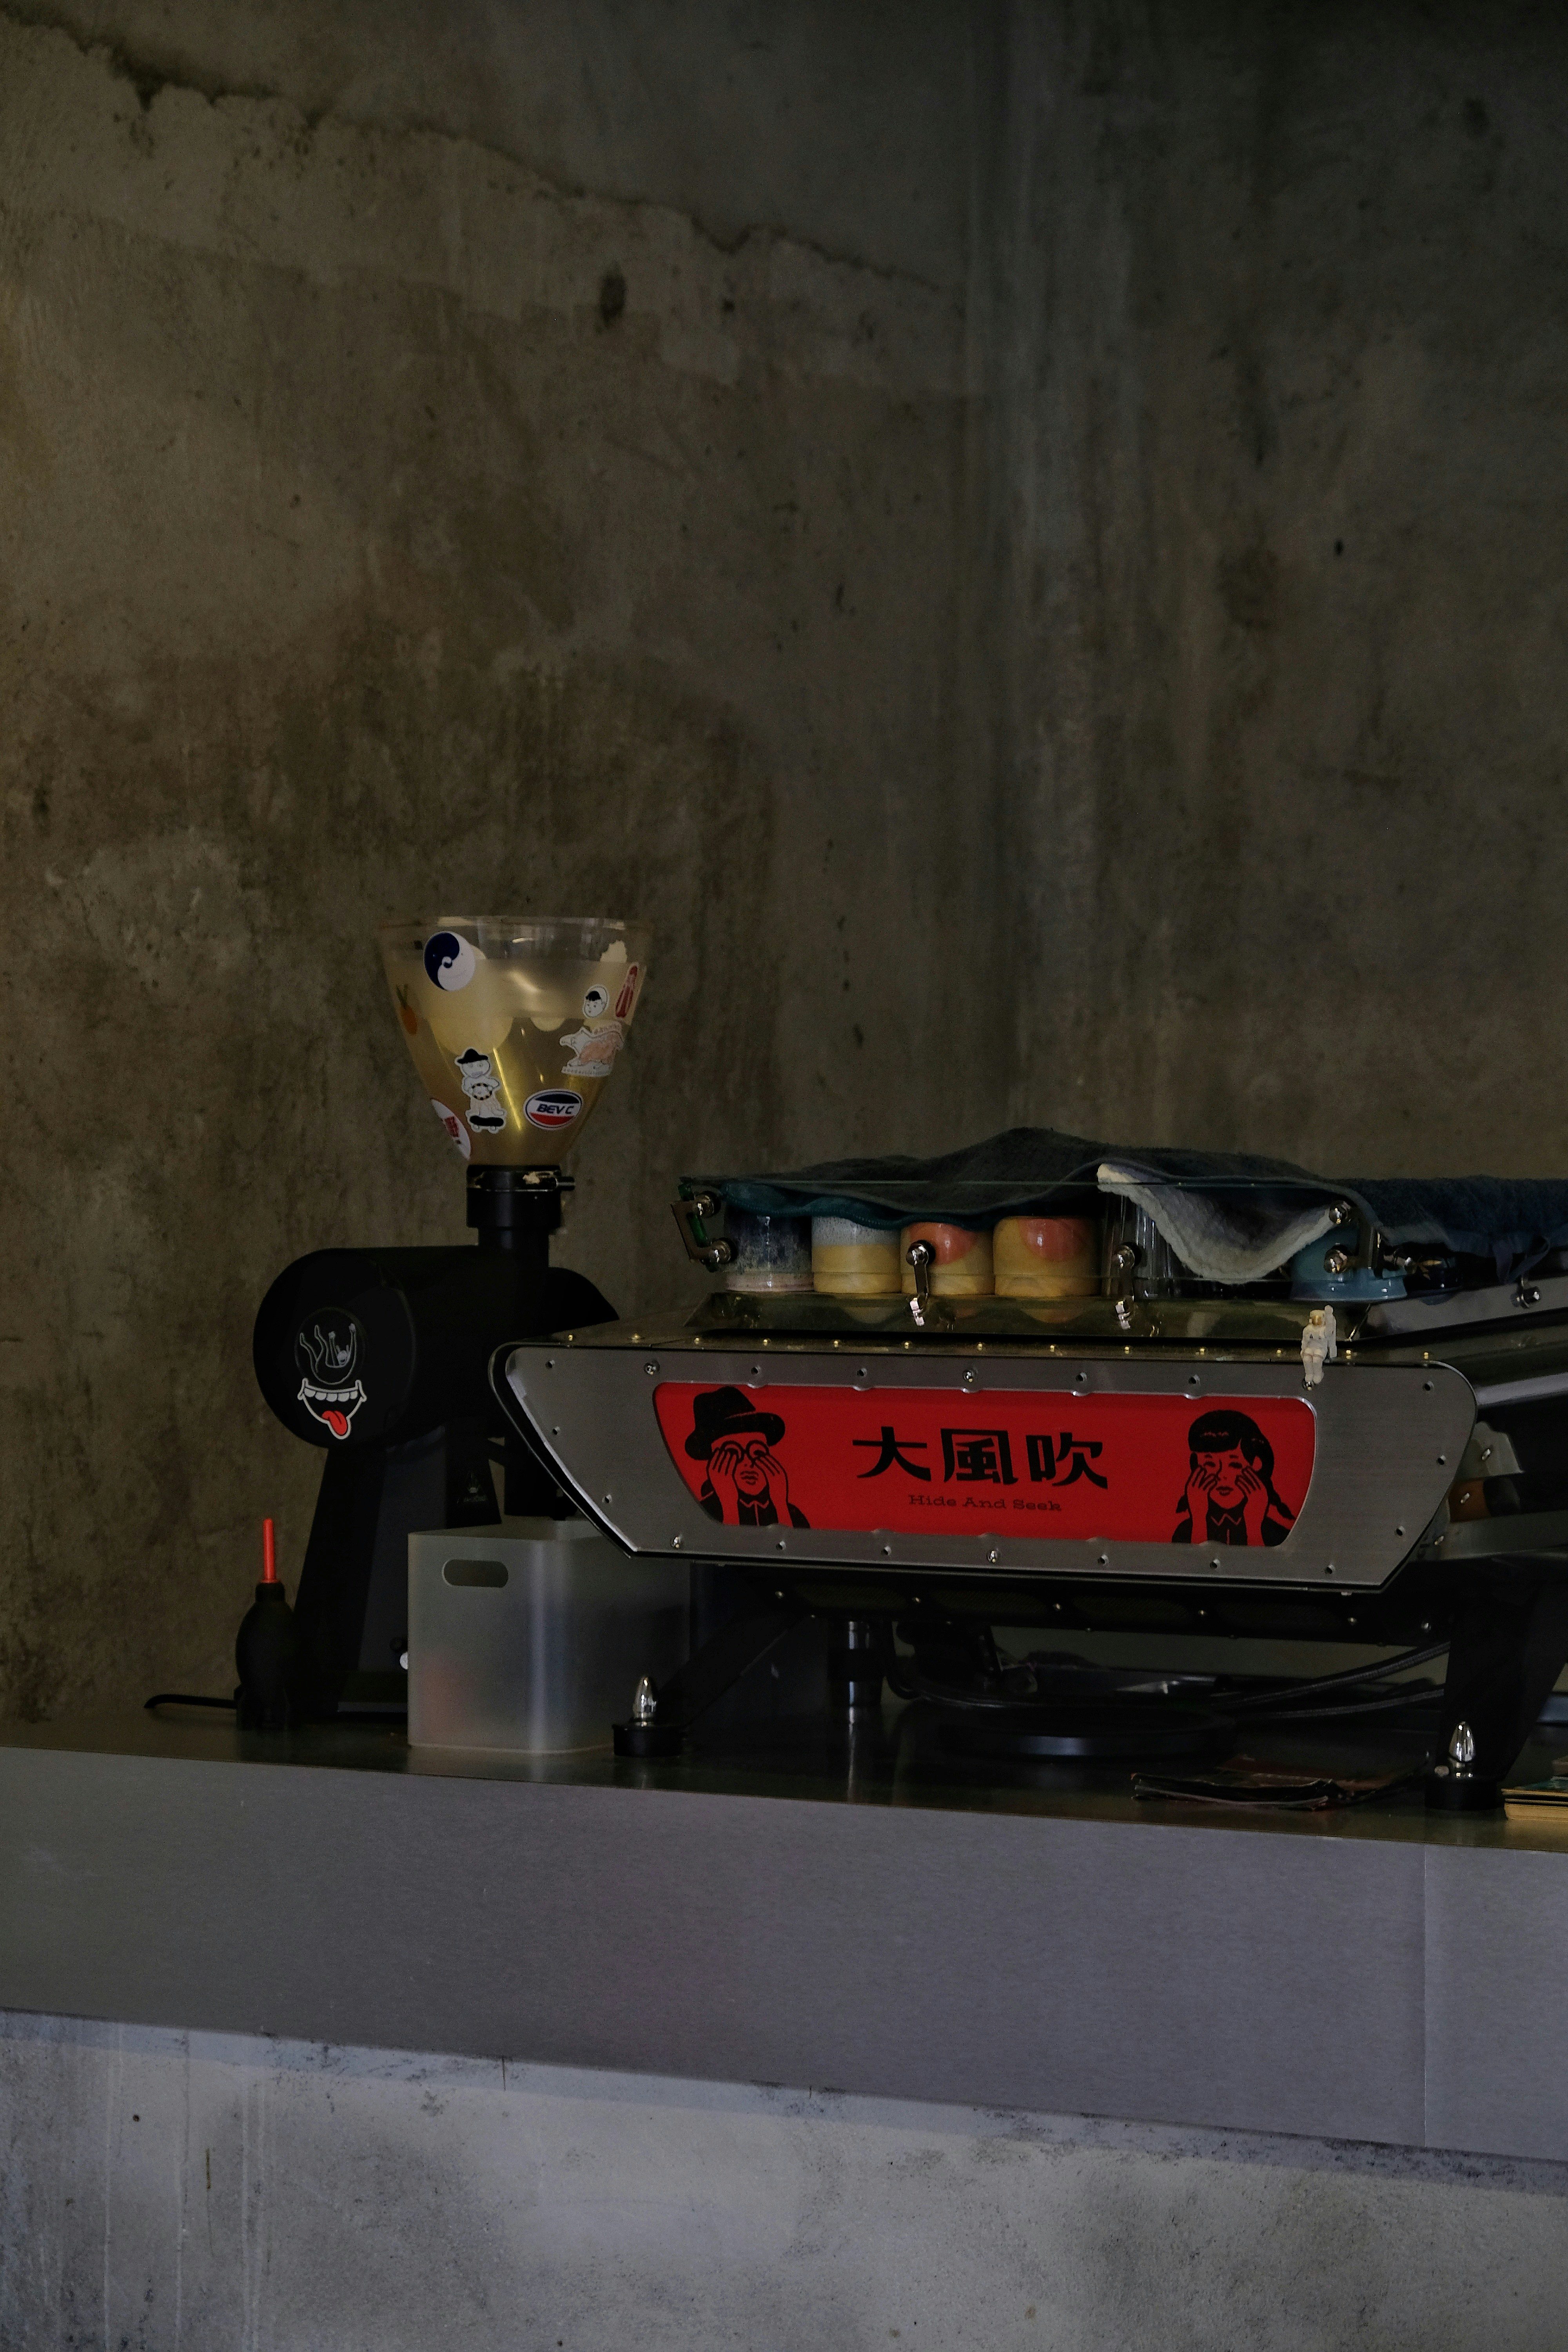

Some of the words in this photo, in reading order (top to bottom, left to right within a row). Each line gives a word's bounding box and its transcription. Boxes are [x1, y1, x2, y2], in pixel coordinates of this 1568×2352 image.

[853, 1426, 1108, 1489] 大風吹
[908, 1494, 956, 1506] Hide
[962, 1497, 1007, 1509] And
[1013, 1499, 1062, 1512] Seek
